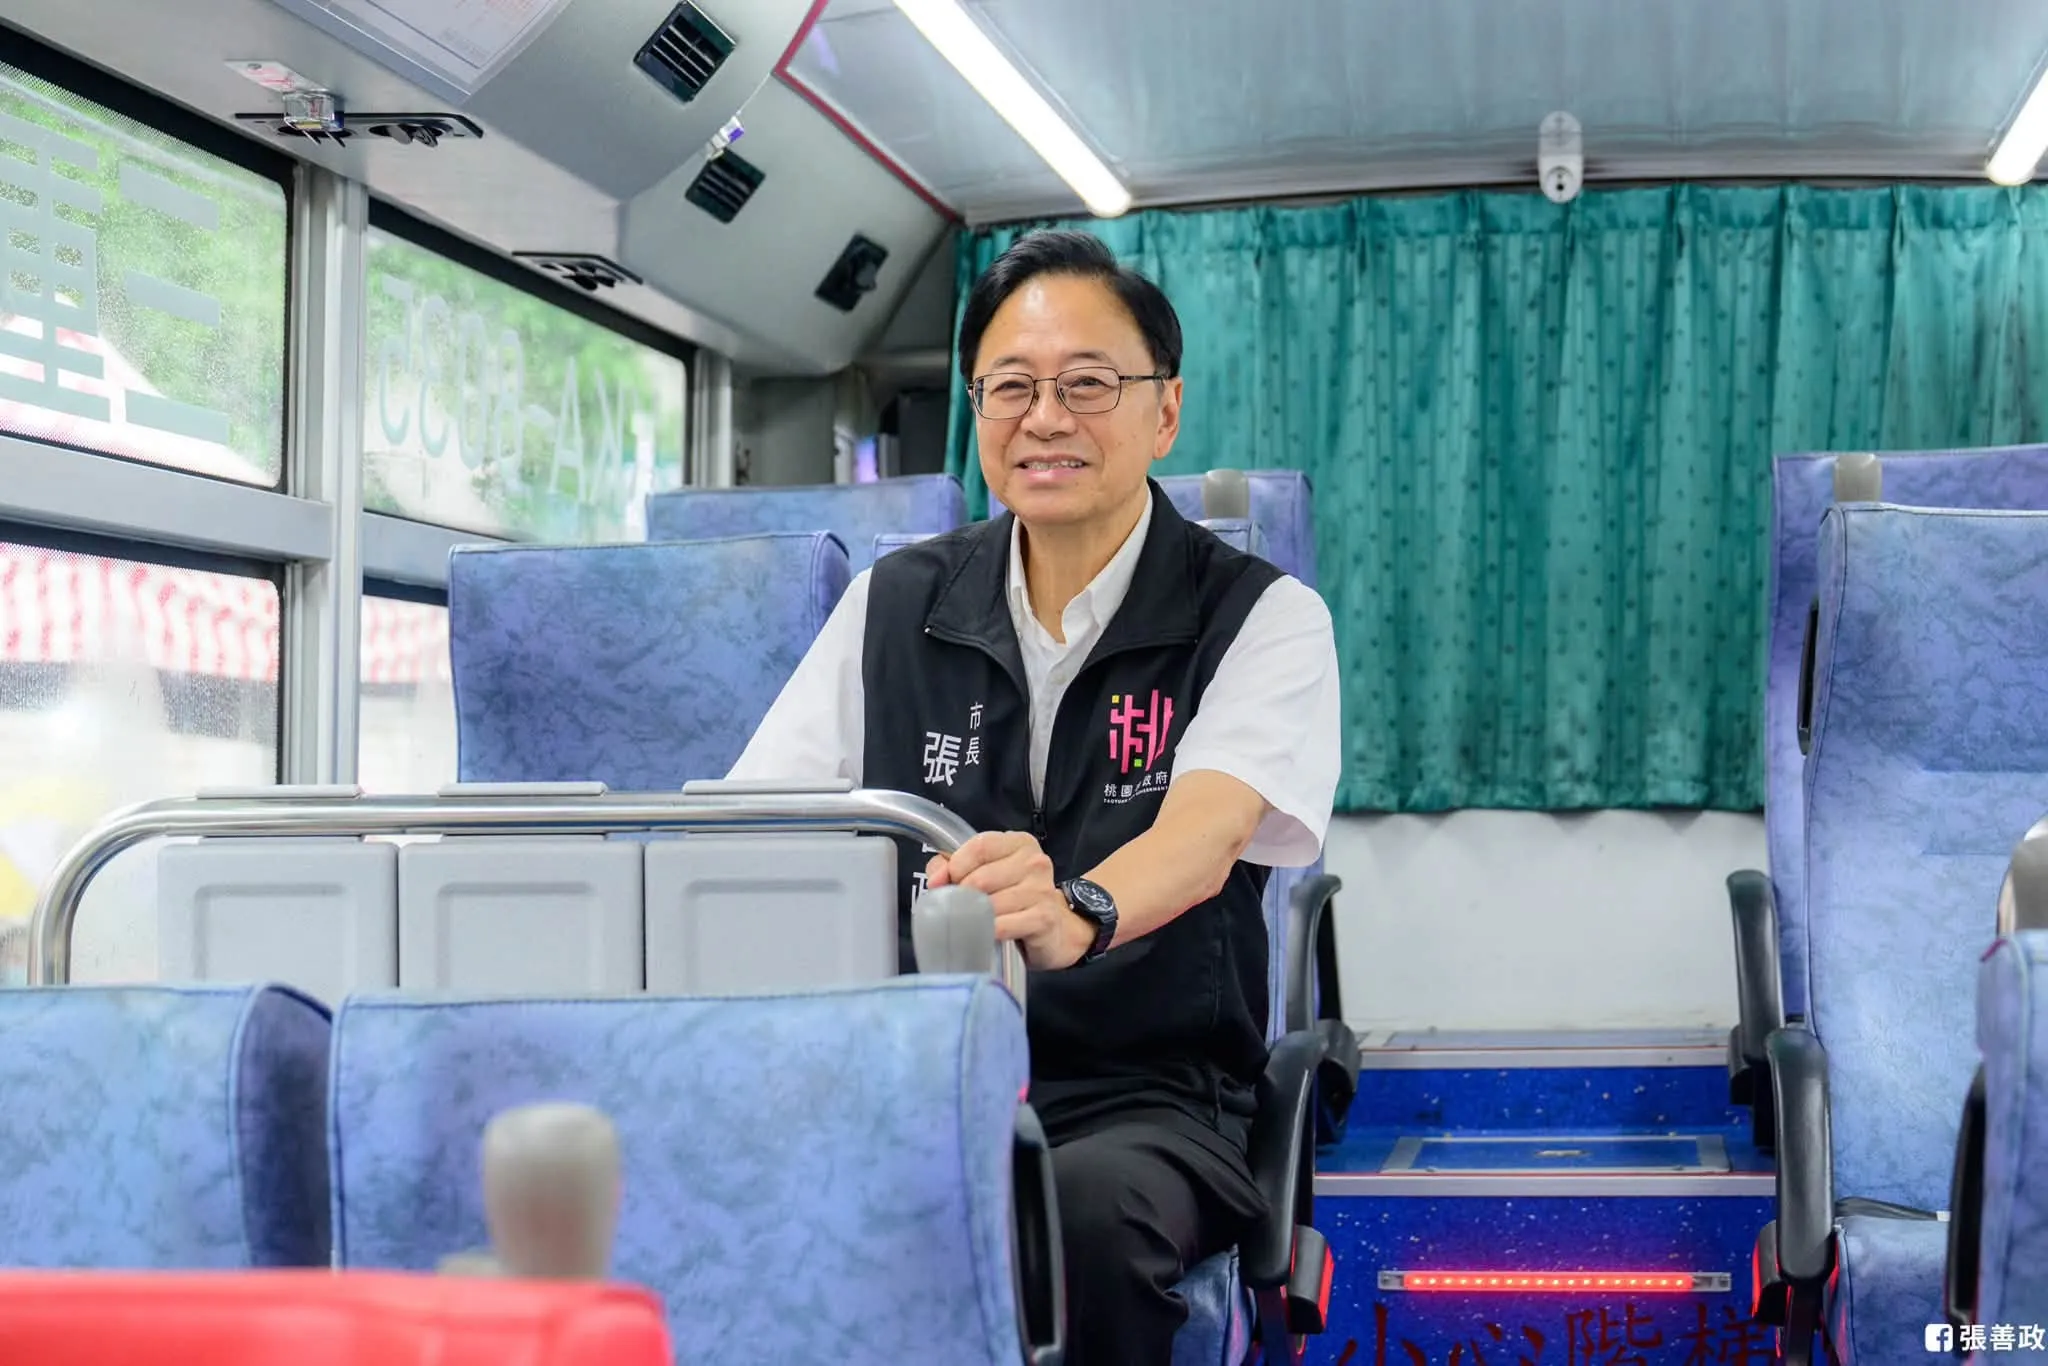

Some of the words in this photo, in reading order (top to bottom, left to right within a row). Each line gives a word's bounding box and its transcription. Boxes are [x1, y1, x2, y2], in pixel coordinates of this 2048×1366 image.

[965, 702, 983, 765] 市長
[1103, 771, 1169, 798] 桃園政府
